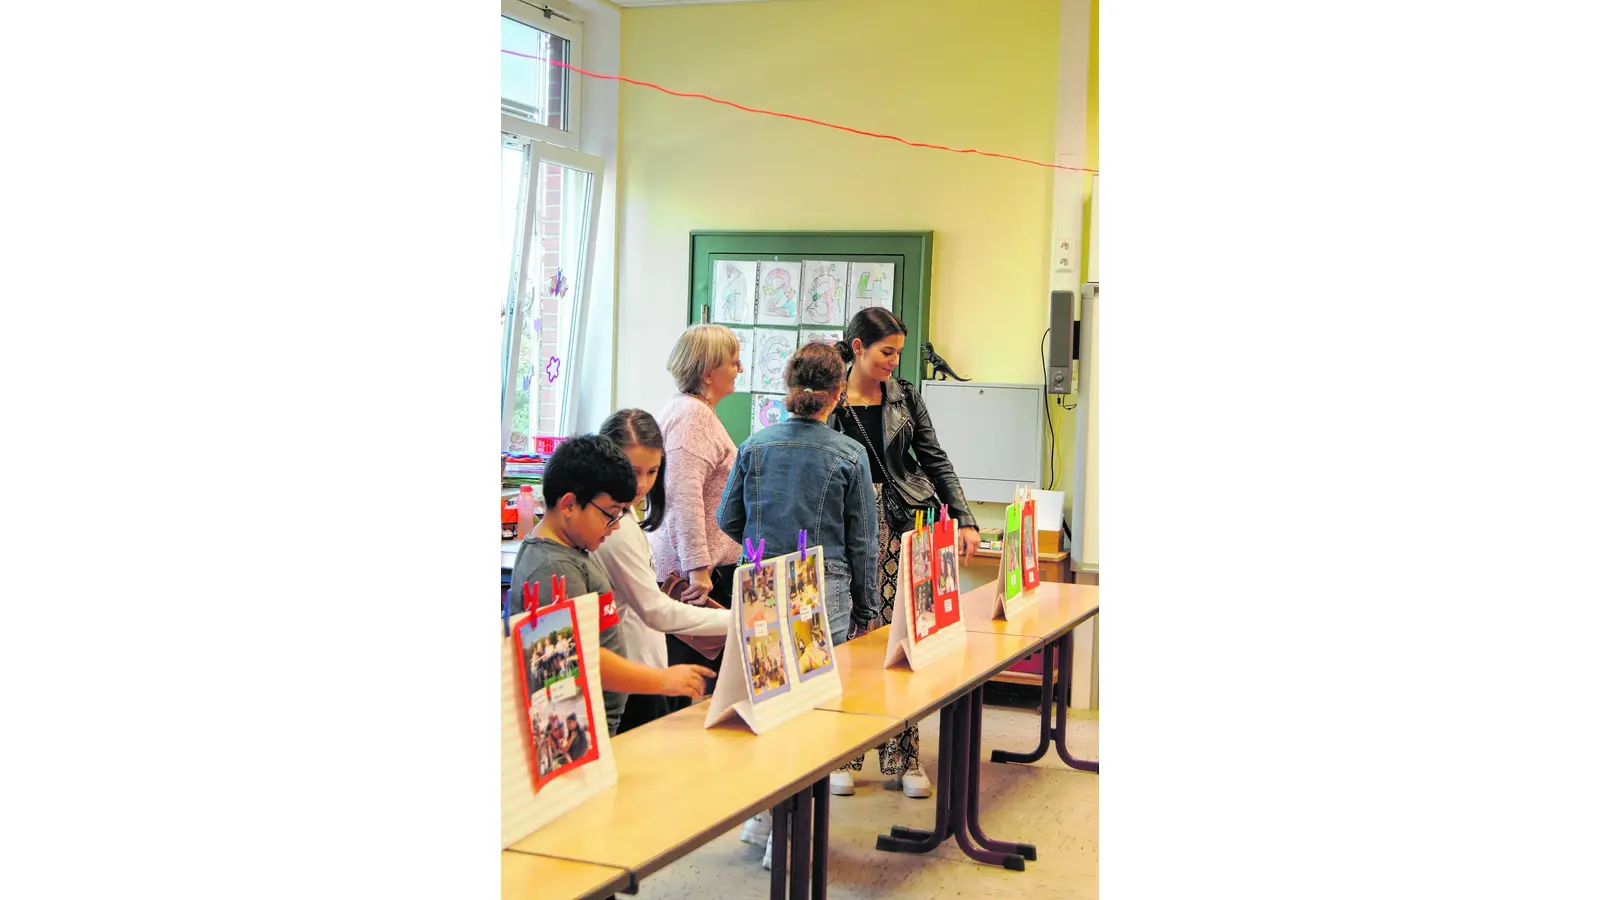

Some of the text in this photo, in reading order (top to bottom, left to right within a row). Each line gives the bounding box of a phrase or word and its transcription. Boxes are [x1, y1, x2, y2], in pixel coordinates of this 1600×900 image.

[764, 268, 796, 318] 2
[807, 274, 837, 323] 3
[856, 271, 889, 308] 4
[760, 336, 790, 381] 6
